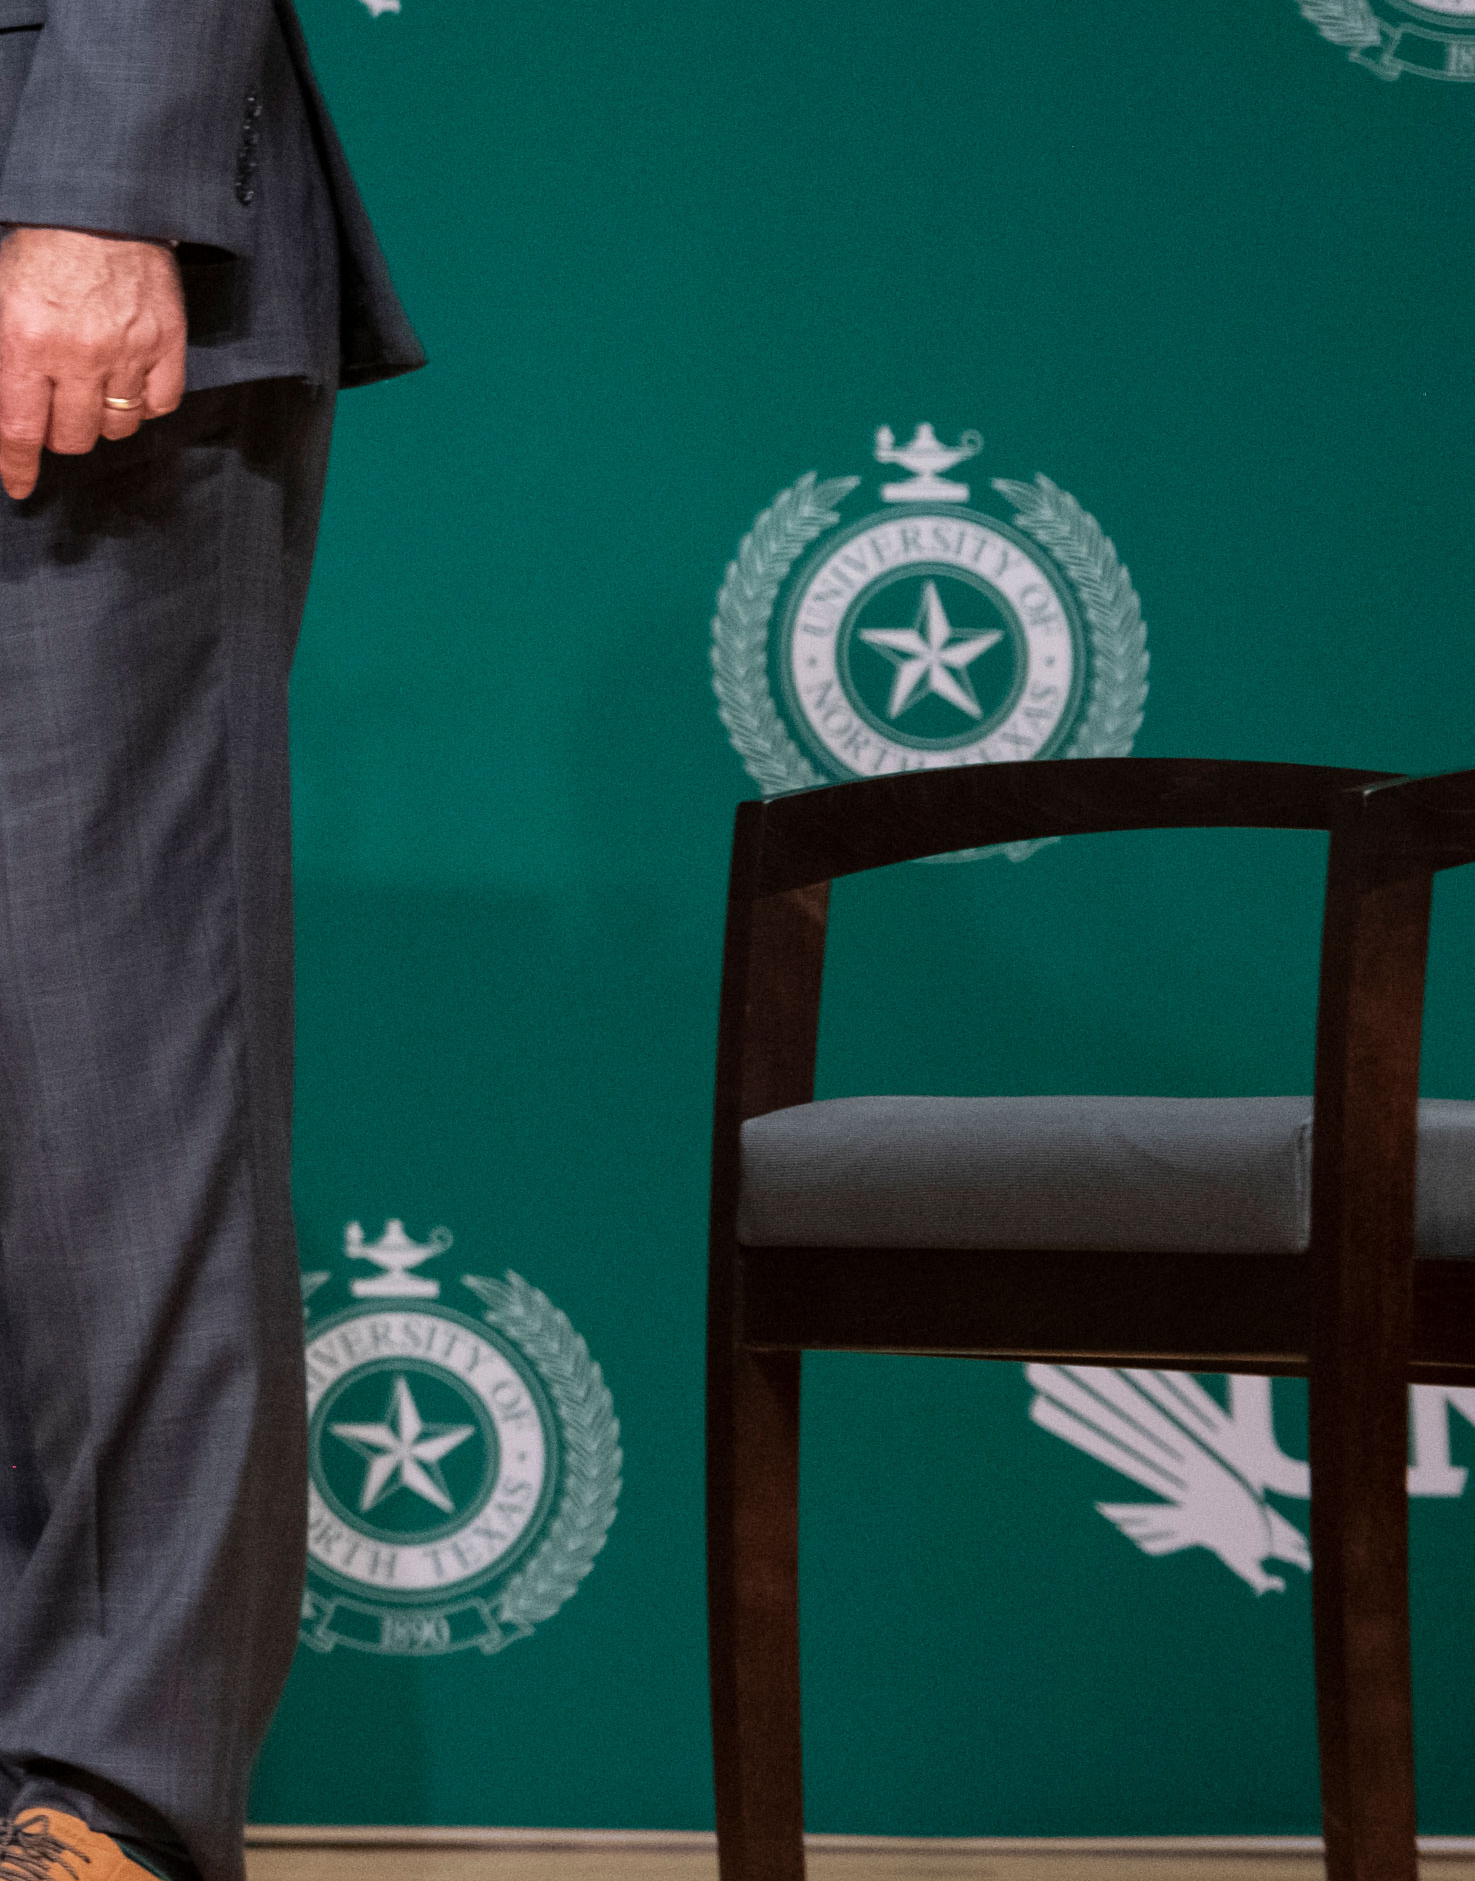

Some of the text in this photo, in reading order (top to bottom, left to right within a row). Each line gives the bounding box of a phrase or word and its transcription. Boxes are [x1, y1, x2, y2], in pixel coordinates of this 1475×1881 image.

[801, 527, 1062, 638] UNIVERSITY OF
[491, 1380, 531, 1424] OF
[425, 1482, 531, 1577] TEXAS
